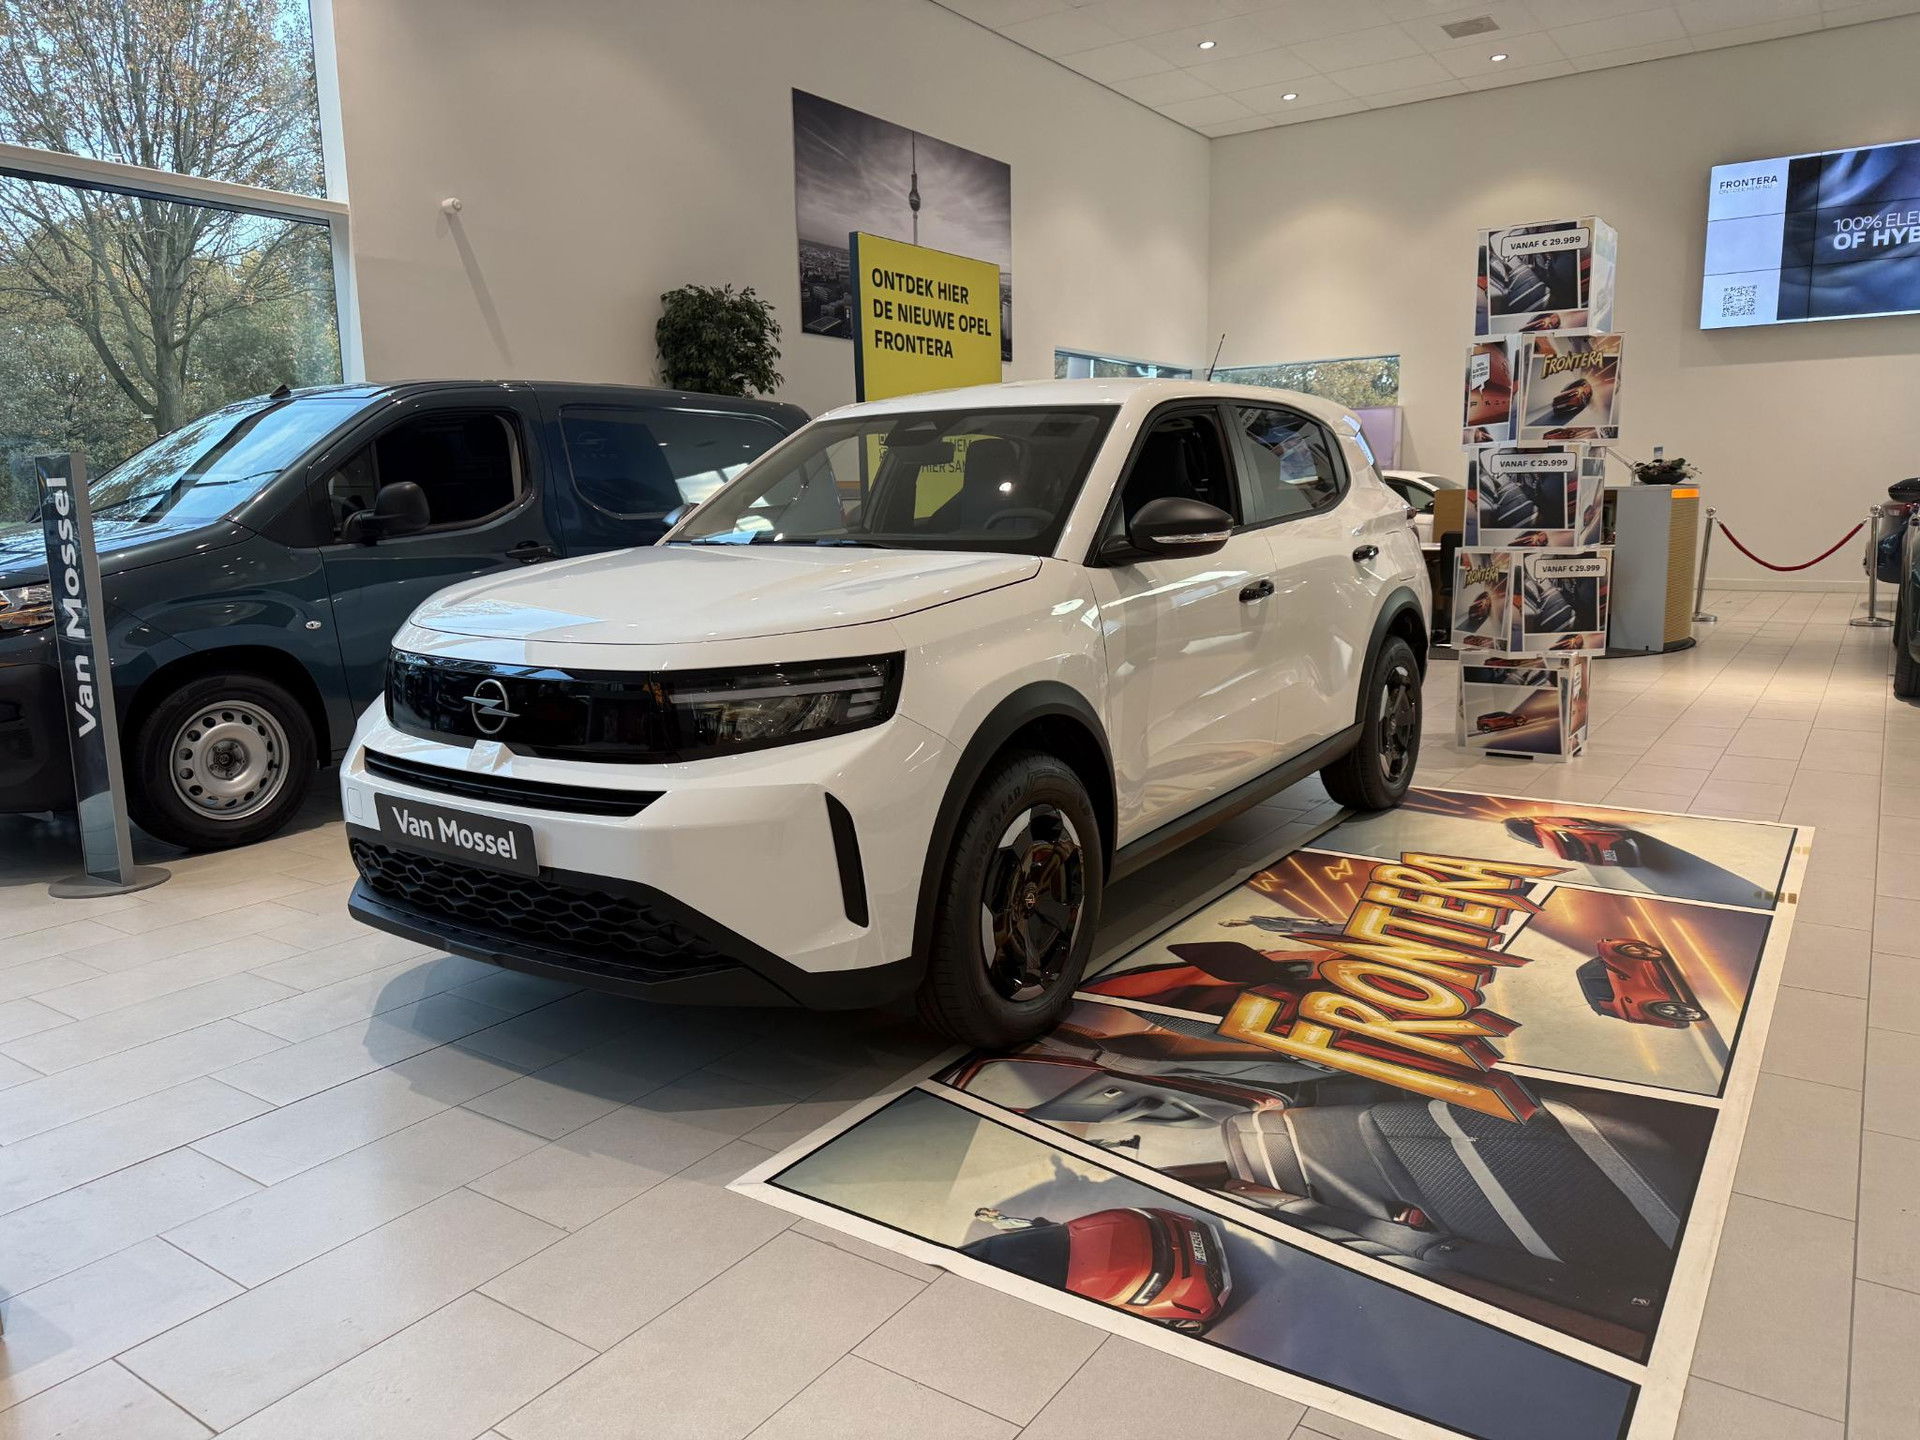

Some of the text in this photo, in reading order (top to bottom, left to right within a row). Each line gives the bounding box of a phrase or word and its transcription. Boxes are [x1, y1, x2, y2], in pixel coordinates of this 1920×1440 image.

[1719, 174, 1778, 190] FRONTERA
[1833, 210, 1920, 232] 100% ELE
[1510, 240, 1540, 250] VANAF
[1550, 235, 1581, 246] 29.999
[1833, 231, 1867, 250] OF
[872, 268, 969, 305] ONTDEK HIER
[873, 299, 992, 336] DE NIEUWE OPEL
[874, 329, 954, 358] FRONTERA
[1540, 350, 1604, 380] FRONTERA
[1530, 459, 1537, 467] €
[1538, 459, 1568, 467] 29.999
[1464, 564, 1499, 588] FRONTERA
[1542, 565, 1567, 573] VANAF
[1575, 564, 1601, 572] 29.999
[45, 477, 97, 738] Van Mossel
[393, 806, 518, 860] Van Mossel
[1216, 851, 1575, 1125] FRONTERA
